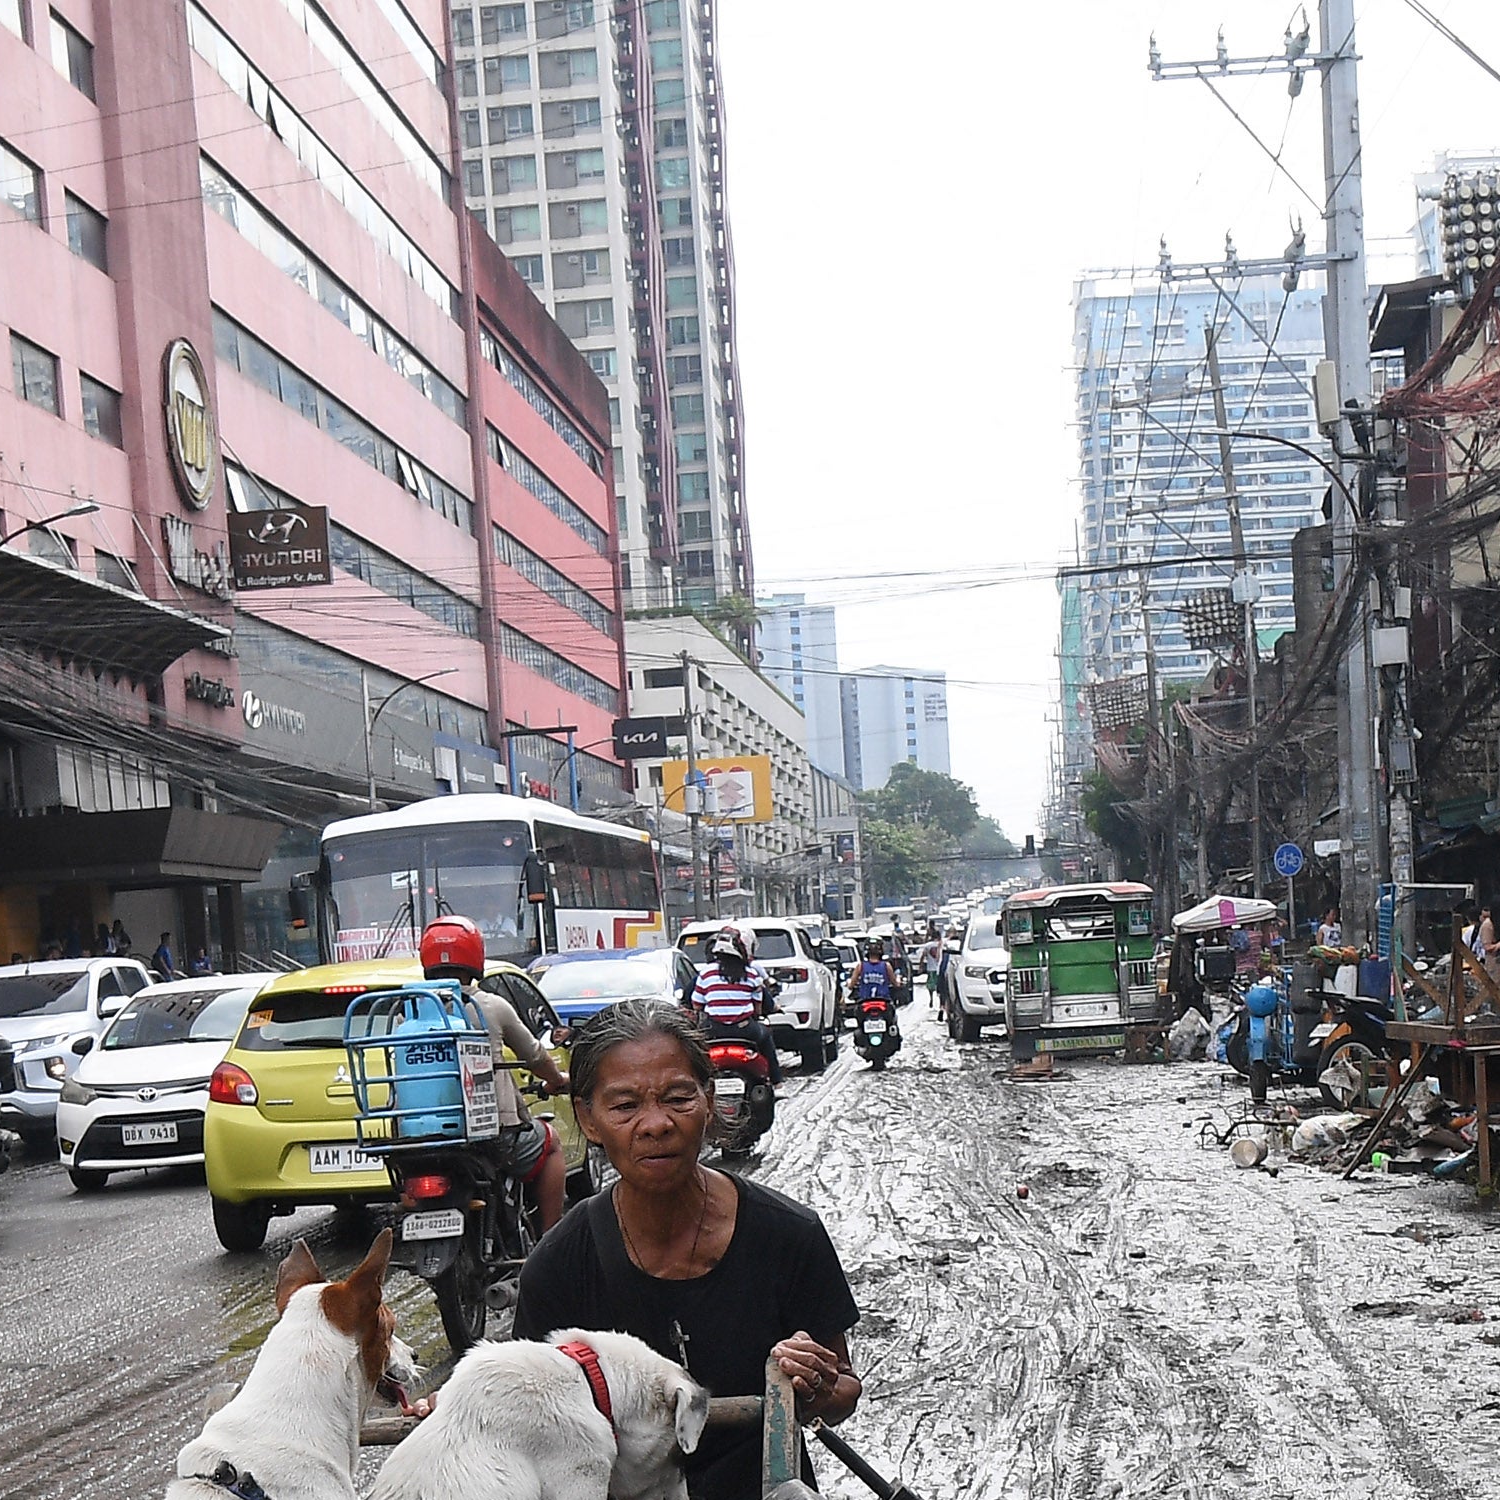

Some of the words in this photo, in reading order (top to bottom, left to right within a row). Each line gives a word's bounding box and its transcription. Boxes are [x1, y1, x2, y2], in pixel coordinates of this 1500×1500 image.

[239, 549, 321, 567] HYUNDAI
[307, 572, 326, 582] Ave.
[406, 1052, 454, 1065] GASUL
[124, 1127, 144, 1142] DBX
[149, 1126, 176, 1140] 9418
[314, 1148, 340, 1165] AAM
